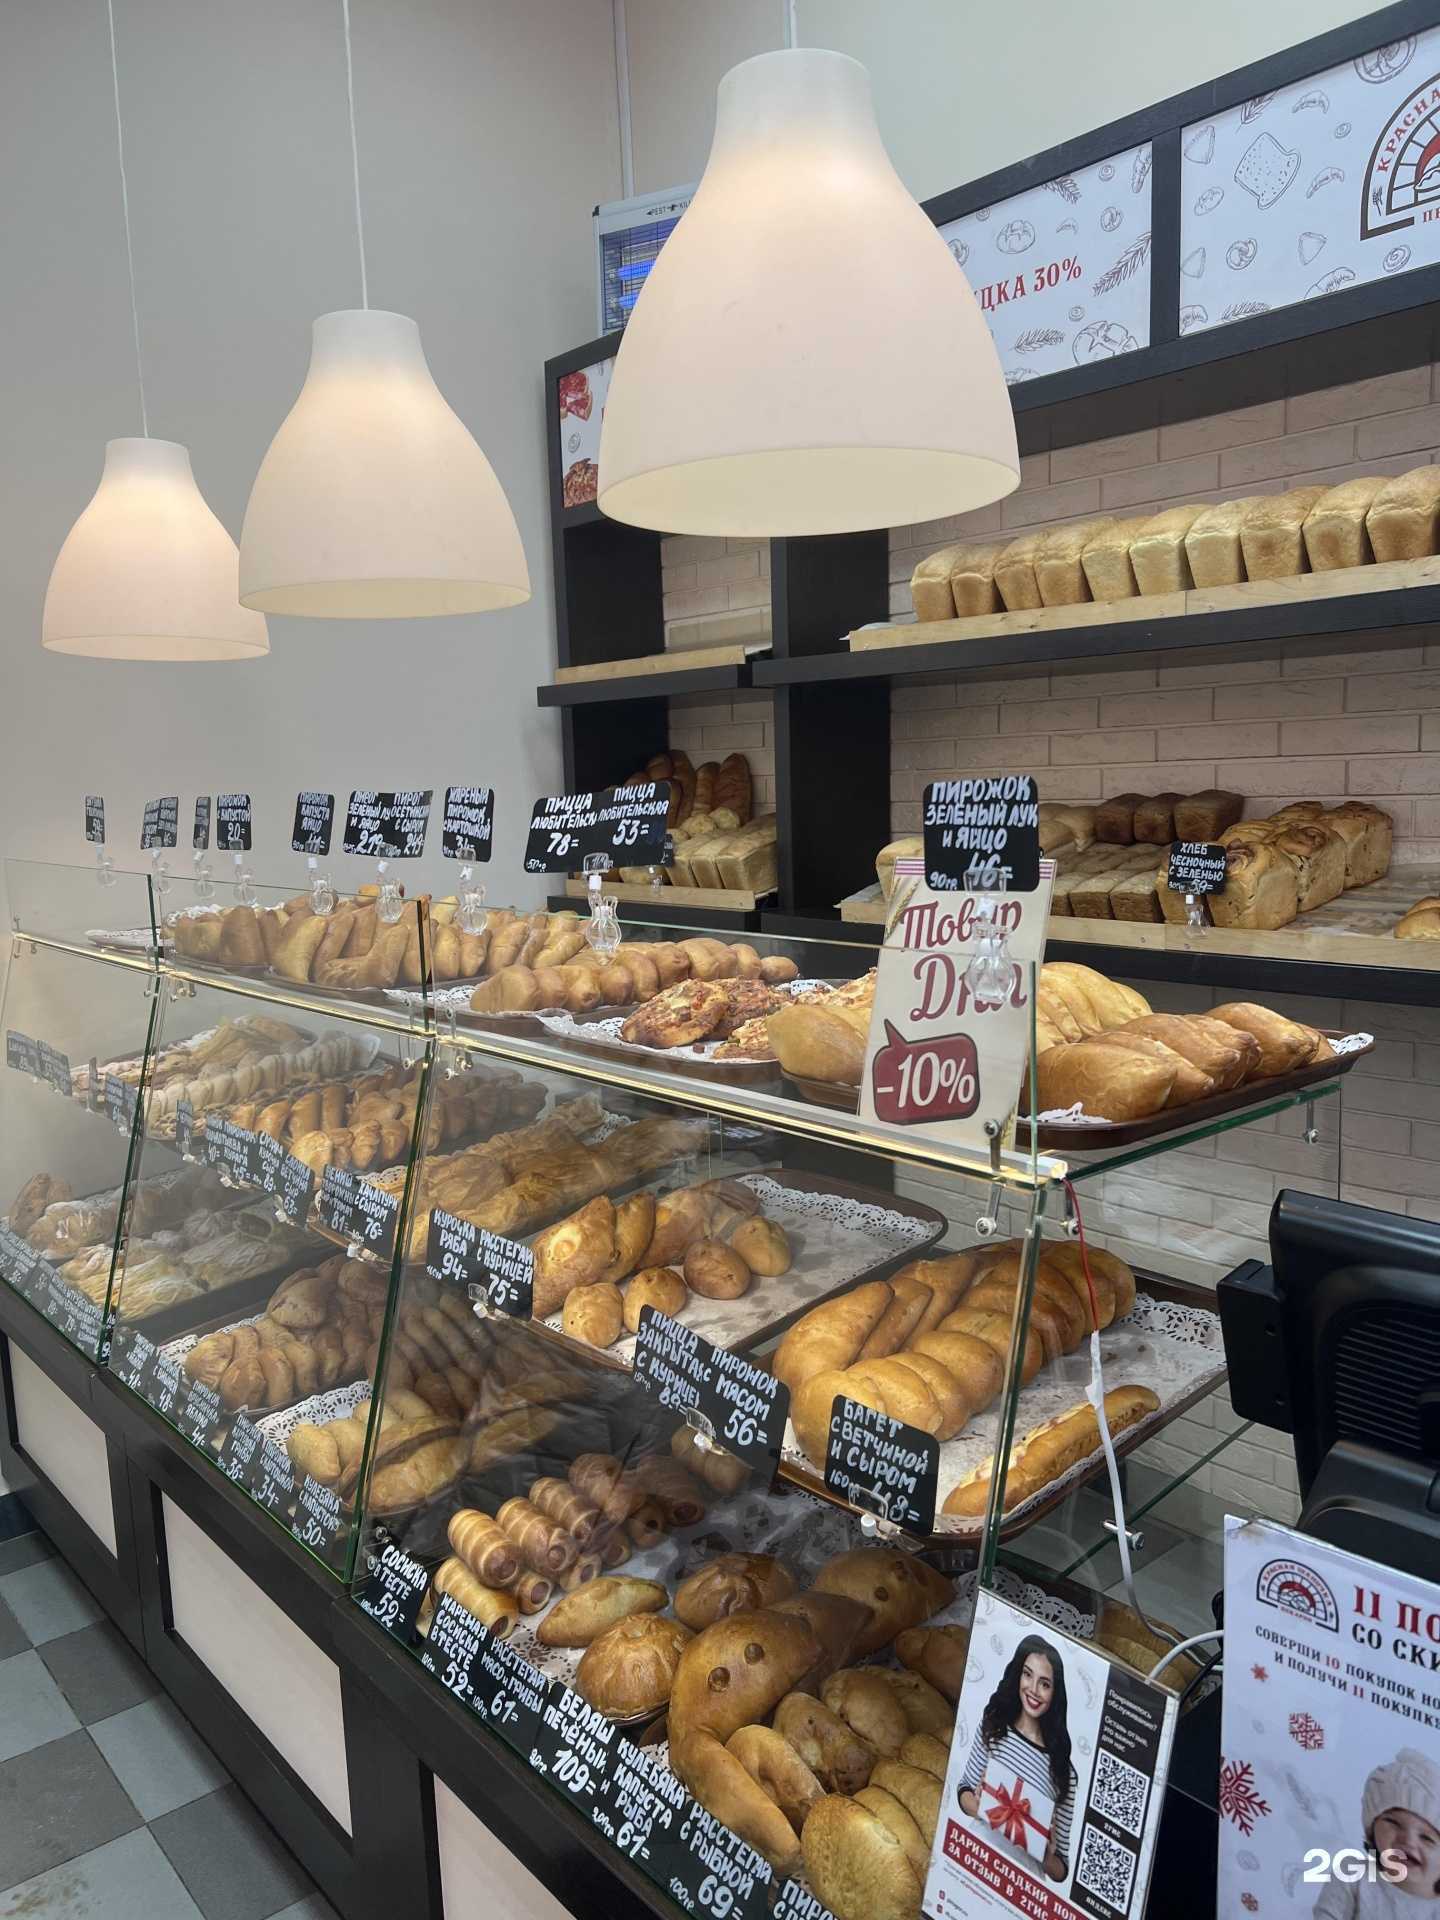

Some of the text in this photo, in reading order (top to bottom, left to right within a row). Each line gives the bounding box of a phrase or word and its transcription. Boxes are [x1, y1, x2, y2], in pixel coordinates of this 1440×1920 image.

[1033, 255, 1083, 293] 30%
[354, 791, 378, 803] ПИРОГ
[393, 791, 425, 806] ПИРОГ
[544, 793, 593, 815] ПИЦЦА
[614, 782, 657, 802] ПИЦЦА
[931, 775, 1032, 804] ПИРОЖОК
[600, 799, 670, 821] ЛЮБИТЕЛЬСКАЯ
[1007, 803, 1038, 828] ЛУК
[955, 826, 1008, 854] ЯЙЦО
[1180, 842, 1208, 855] ХЛЕБ
[1170, 853, 1226, 871] ЧЕСНОЧНЫЙ
[1176, 866, 1224, 882] ЗЕЛЕНЬЮ
[876, 1052, 976, 1109] -10%
[358, 1182, 399, 1212] ХАЧАПУРИ
[358, 1196, 389, 1223] СЫРОМ
[364, 1216, 383, 1240] 76=
[433, 1208, 476, 1243] КУРОЧКА
[439, 1229, 467, 1257] РЯБА
[441, 1252, 469, 1281] 94=
[483, 1249, 534, 1285] КУРИЦЕЙ
[487, 1272, 520, 1306] 75=
[650, 1310, 699, 1354] ПИЦЦА
[636, 1351, 648, 1368] С
[710, 1347, 779, 1399] ПИРОЖОК
[715, 1373, 771, 1422] МЯСОМ
[724, 1408, 769, 1446] 56=
[843, 1398, 904, 1438] БАГЕТ
[841, 1420, 929, 1475] ВЕТЧИНОЙ
[846, 1446, 918, 1495] СЫРОМ
[257, 1474, 280, 1508] 34=
[303, 1473, 342, 1514] КУЛЕБЯКА
[302, 1517, 327, 1547] 50=
[378, 1566, 413, 1601] ТЕСТЕ
[381, 1545, 428, 1591] СОСИСКА
[374, 1591, 406, 1628] 52=
[435, 1610, 480, 1656] СОСИСКА
[436, 1630, 474, 1671] ТЕСТЕ
[1351, 1622, 1382, 1650] СО
[441, 1661, 475, 1702] 52=
[490, 1636, 547, 1692] РАССТЕГАЙ
[1254, 1624, 1321, 1663] СОВЕРШИ
[1325, 1655, 1341, 1671] 10
[1345, 1663, 1416, 1701] ПОКУПОК
[1274, 1650, 1285, 1665] И
[1287, 1657, 1348, 1692] ПОЛУЧИ
[481, 1650, 506, 1682] МЯСО
[507, 1676, 544, 1714] ГРИБЫ
[558, 1688, 616, 1745] БЕЛЯШ
[551, 1748, 597, 1796] 109=
[616, 1737, 686, 1810] КУЛЕБЯКА
[612, 1763, 673, 1830] КАПУСТА
[614, 1790, 653, 1839] РЫБА
[689, 1801, 773, 1885] РАССТЕГАЙ
[689, 1830, 755, 1901] РЫБКОЙ
[947, 1841, 1050, 1920] ЗА ОТЗЫВ В 2ГИС
[949, 1827, 990, 1863] ДАРИМ
[992, 1859, 1049, 1907] СЛАДКИЙ
[697, 1874, 744, 1920] 69=
